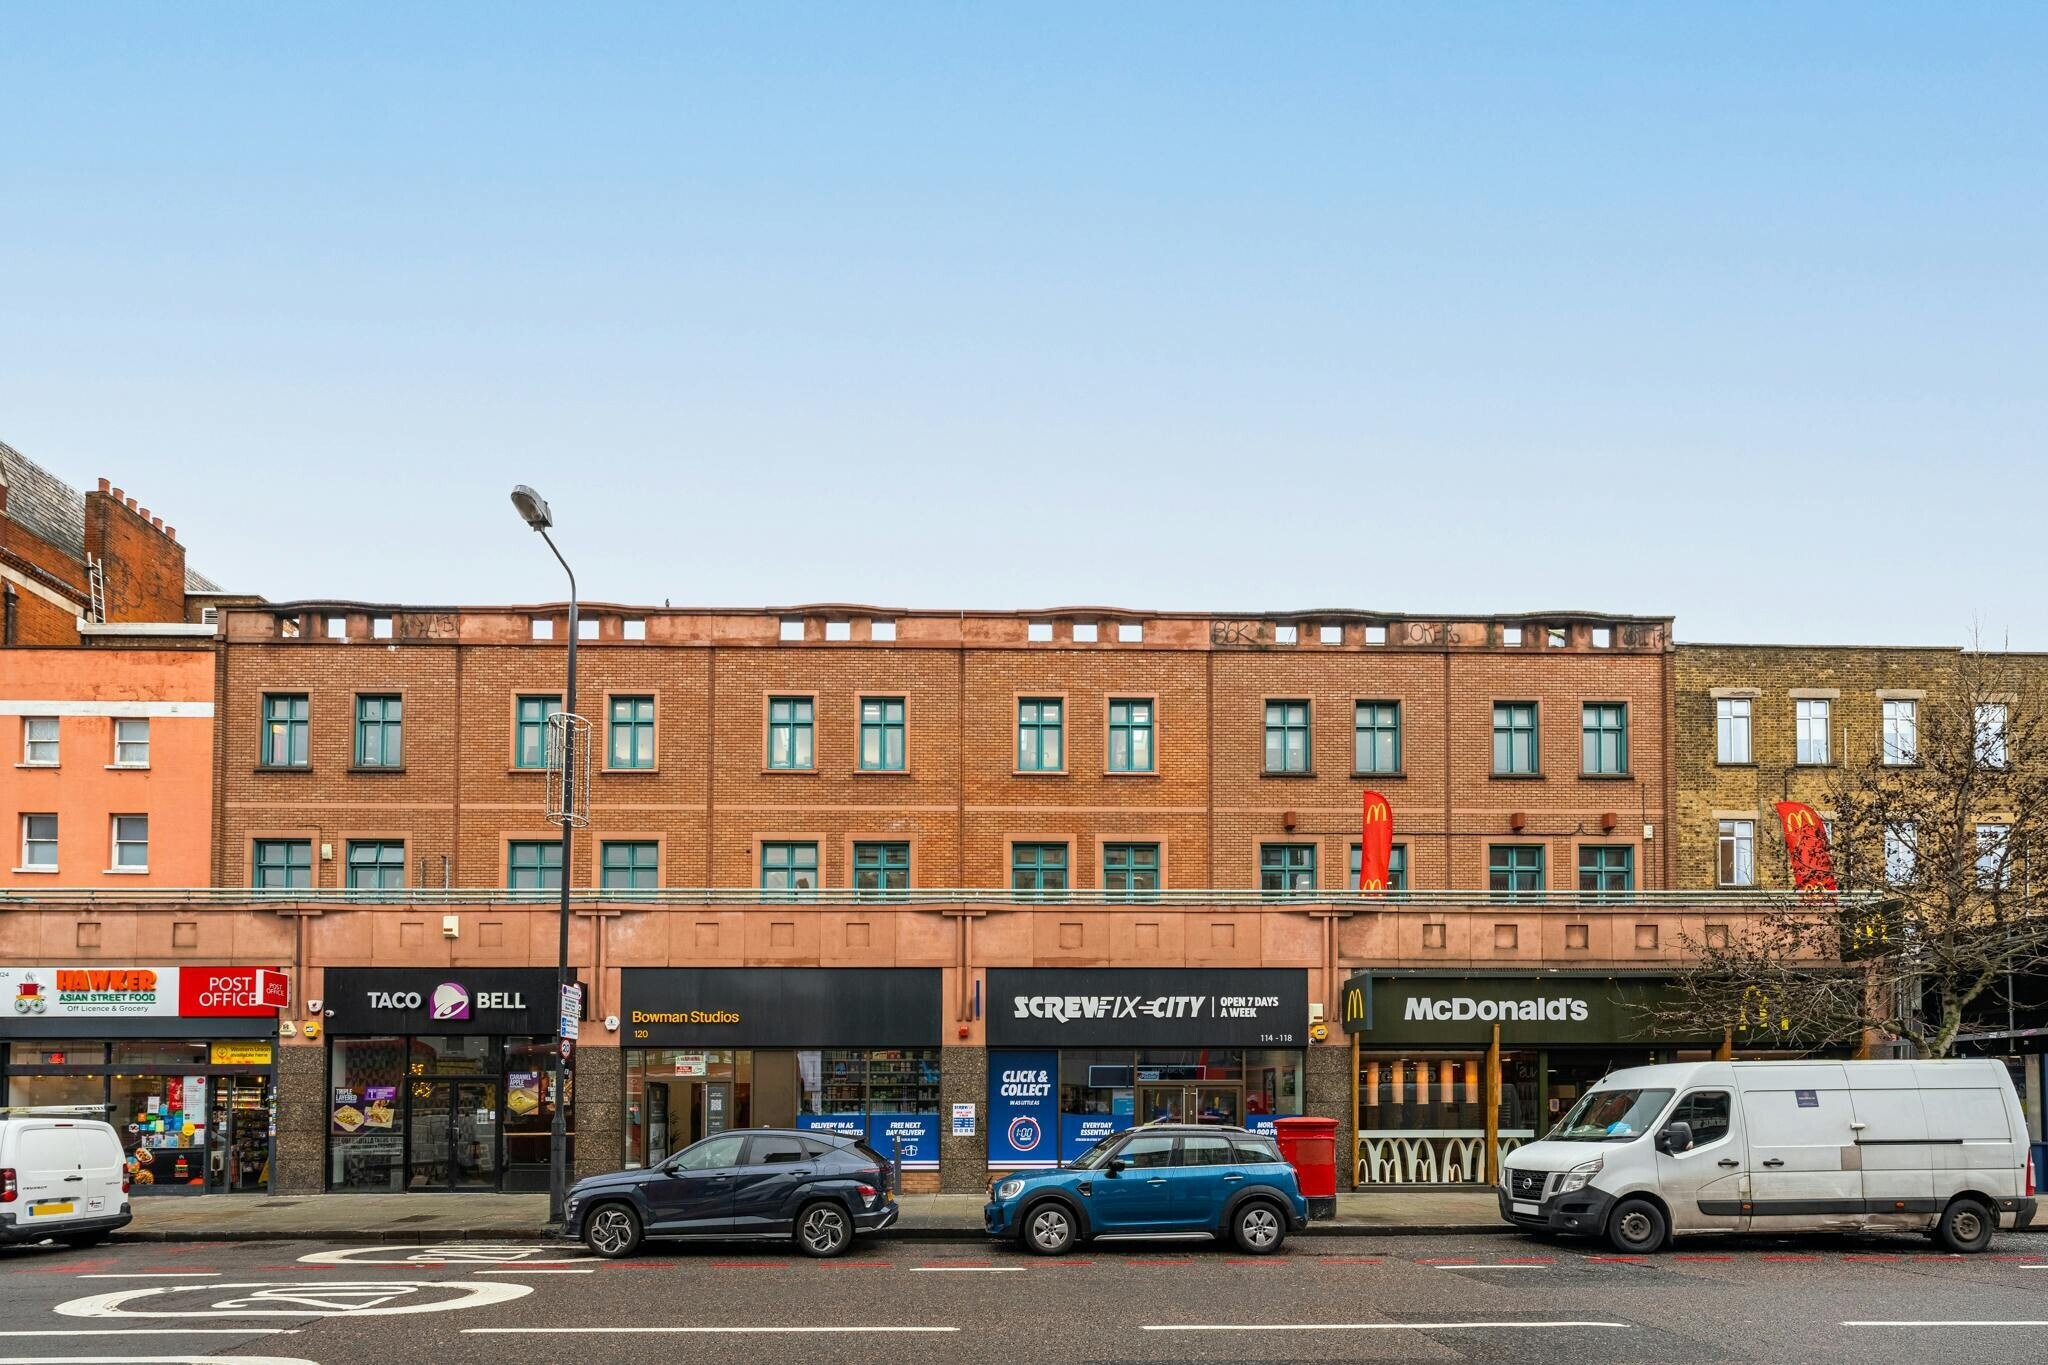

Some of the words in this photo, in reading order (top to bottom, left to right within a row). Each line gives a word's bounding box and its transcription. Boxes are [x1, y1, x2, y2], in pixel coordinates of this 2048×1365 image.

[56, 969, 157, 991] HAWKER
[209, 977, 252, 991] POST
[59, 993, 88, 1001] ASIAN
[90, 993, 127, 1001] STREET
[129, 993, 156, 1001] FOOD
[266, 988, 285, 996] OFFICE
[199, 992, 258, 1006] OFFICE
[367, 992, 421, 1008] TACO
[477, 992, 526, 1008] BELL
[1220, 996, 1246, 1007] OPEN
[1247, 996, 1254, 1007] 7
[1255, 996, 1279, 1007] DAYS
[118, 1005, 149, 1013] Grocery
[1220, 1007, 1228, 1018] A
[1229, 1007, 1257, 1018] WEEK
[1404, 997, 1589, 1021] McDonald's
[632, 1010, 688, 1023] Bowman
[690, 1010, 740, 1023] Studios
[634, 1030, 649, 1038] 120
[1260, 1034, 1273, 1042] 114
[563, 1043, 569, 1053] 20
[1002, 1070, 1036, 1082] CLICK
[1037, 1070, 1048, 1082] &
[1000, 1084, 1051, 1096] COLLECT
